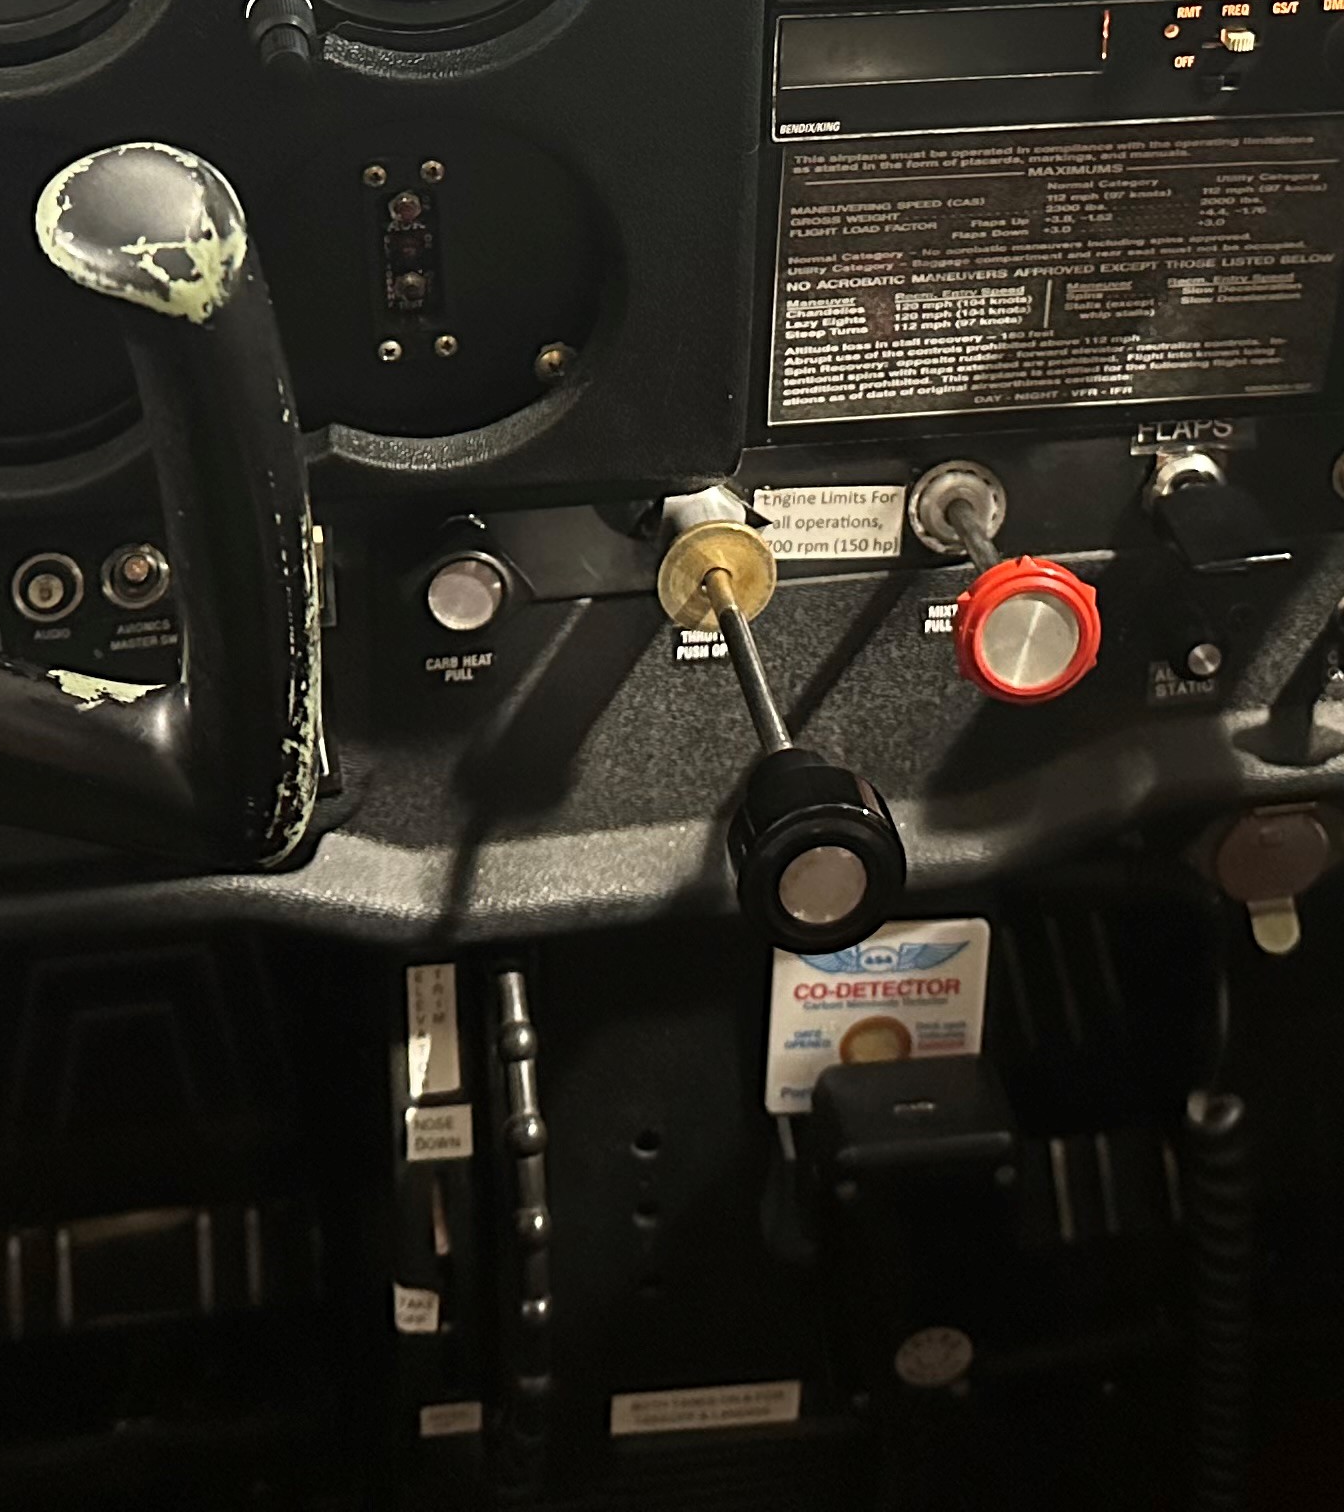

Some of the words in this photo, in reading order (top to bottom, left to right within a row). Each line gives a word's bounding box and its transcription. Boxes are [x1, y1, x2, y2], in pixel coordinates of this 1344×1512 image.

[1177, 6, 1202, 18] RMT
[1222, 4, 1250, 16] FREQ
[1272, 1, 1299, 14] GS/T
[1174, 55, 1195, 69] OFF
[779, 121, 840, 135] BENDIX/KING
[786, 281, 811, 293] NO
[816, 275, 905, 290] ACROBATIC
[911, 269, 1007, 284] MANEUVERS
[1013, 263, 1098, 279] APPROVED
[1100, 261, 1158, 274] EXCEPT
[1166, 258, 1216, 270] THOSE
[1222, 255, 1275, 268] LISTED
[1280, 253, 1335, 265] BELOW
[762, 491, 816, 508] Engine
[821, 490, 866, 505] Limits
[871, 490, 897, 504] For
[772, 514, 789, 529] all
[793, 513, 884, 532] operations,
[425, 656, 459, 671] CARB
[462, 653, 493, 667] HEAT
[444, 666, 474, 681] PULL
[793, 978, 961, 1002] CO-DETECTOR
